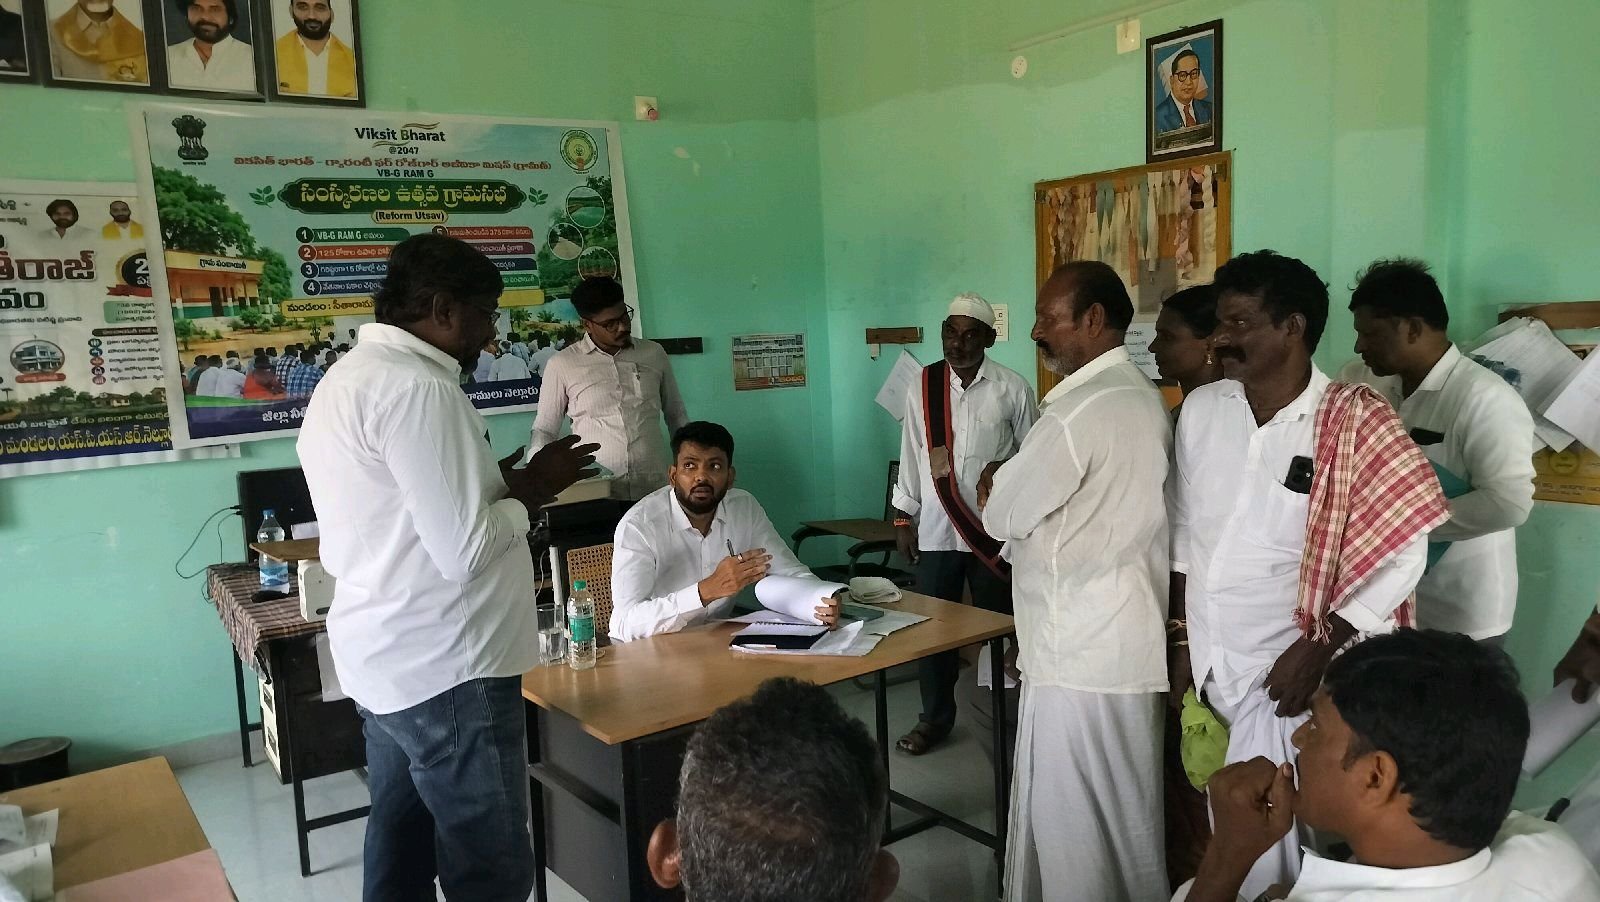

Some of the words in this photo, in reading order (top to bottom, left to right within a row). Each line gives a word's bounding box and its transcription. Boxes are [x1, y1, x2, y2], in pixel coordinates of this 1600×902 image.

[354, 127, 397, 141] Viksit
[400, 129, 446, 142] Bharat
[388, 146, 419, 155] @2047
[233, 156, 275, 166] వికసిత్
[278, 156, 315, 167] భారత్
[325, 157, 373, 168] గ్యారంటీ
[377, 169, 401, 178] VB-G
[403, 169, 425, 178] RAM
[427, 169, 434, 178] G
[300, 183, 391, 209] సంస్కరణల
[396, 184, 439, 207] ఉత్సవ
[443, 185, 507, 208] గ్రామసభ
[375, 211, 413, 221] (Reform
[415, 211, 444, 221] Utsav)
[317, 231, 336, 239] VB-G
[337, 231, 355, 239] RAM
[355, 231, 362, 239] G
[303, 247, 311, 258] 2
[318, 249, 335, 257] 125
[305, 265, 313, 275] 3
[307, 282, 316, 292] 4
[287, 303, 327, 312] మండలం
[332, 299, 373, 309] సీతారామ
[466, 390, 503, 401] రాములు
[504, 386, 539, 400] నెల్లూరు
[262, 410, 289, 424] జిల్లా
[0, 420, 28, 430] యతీ
